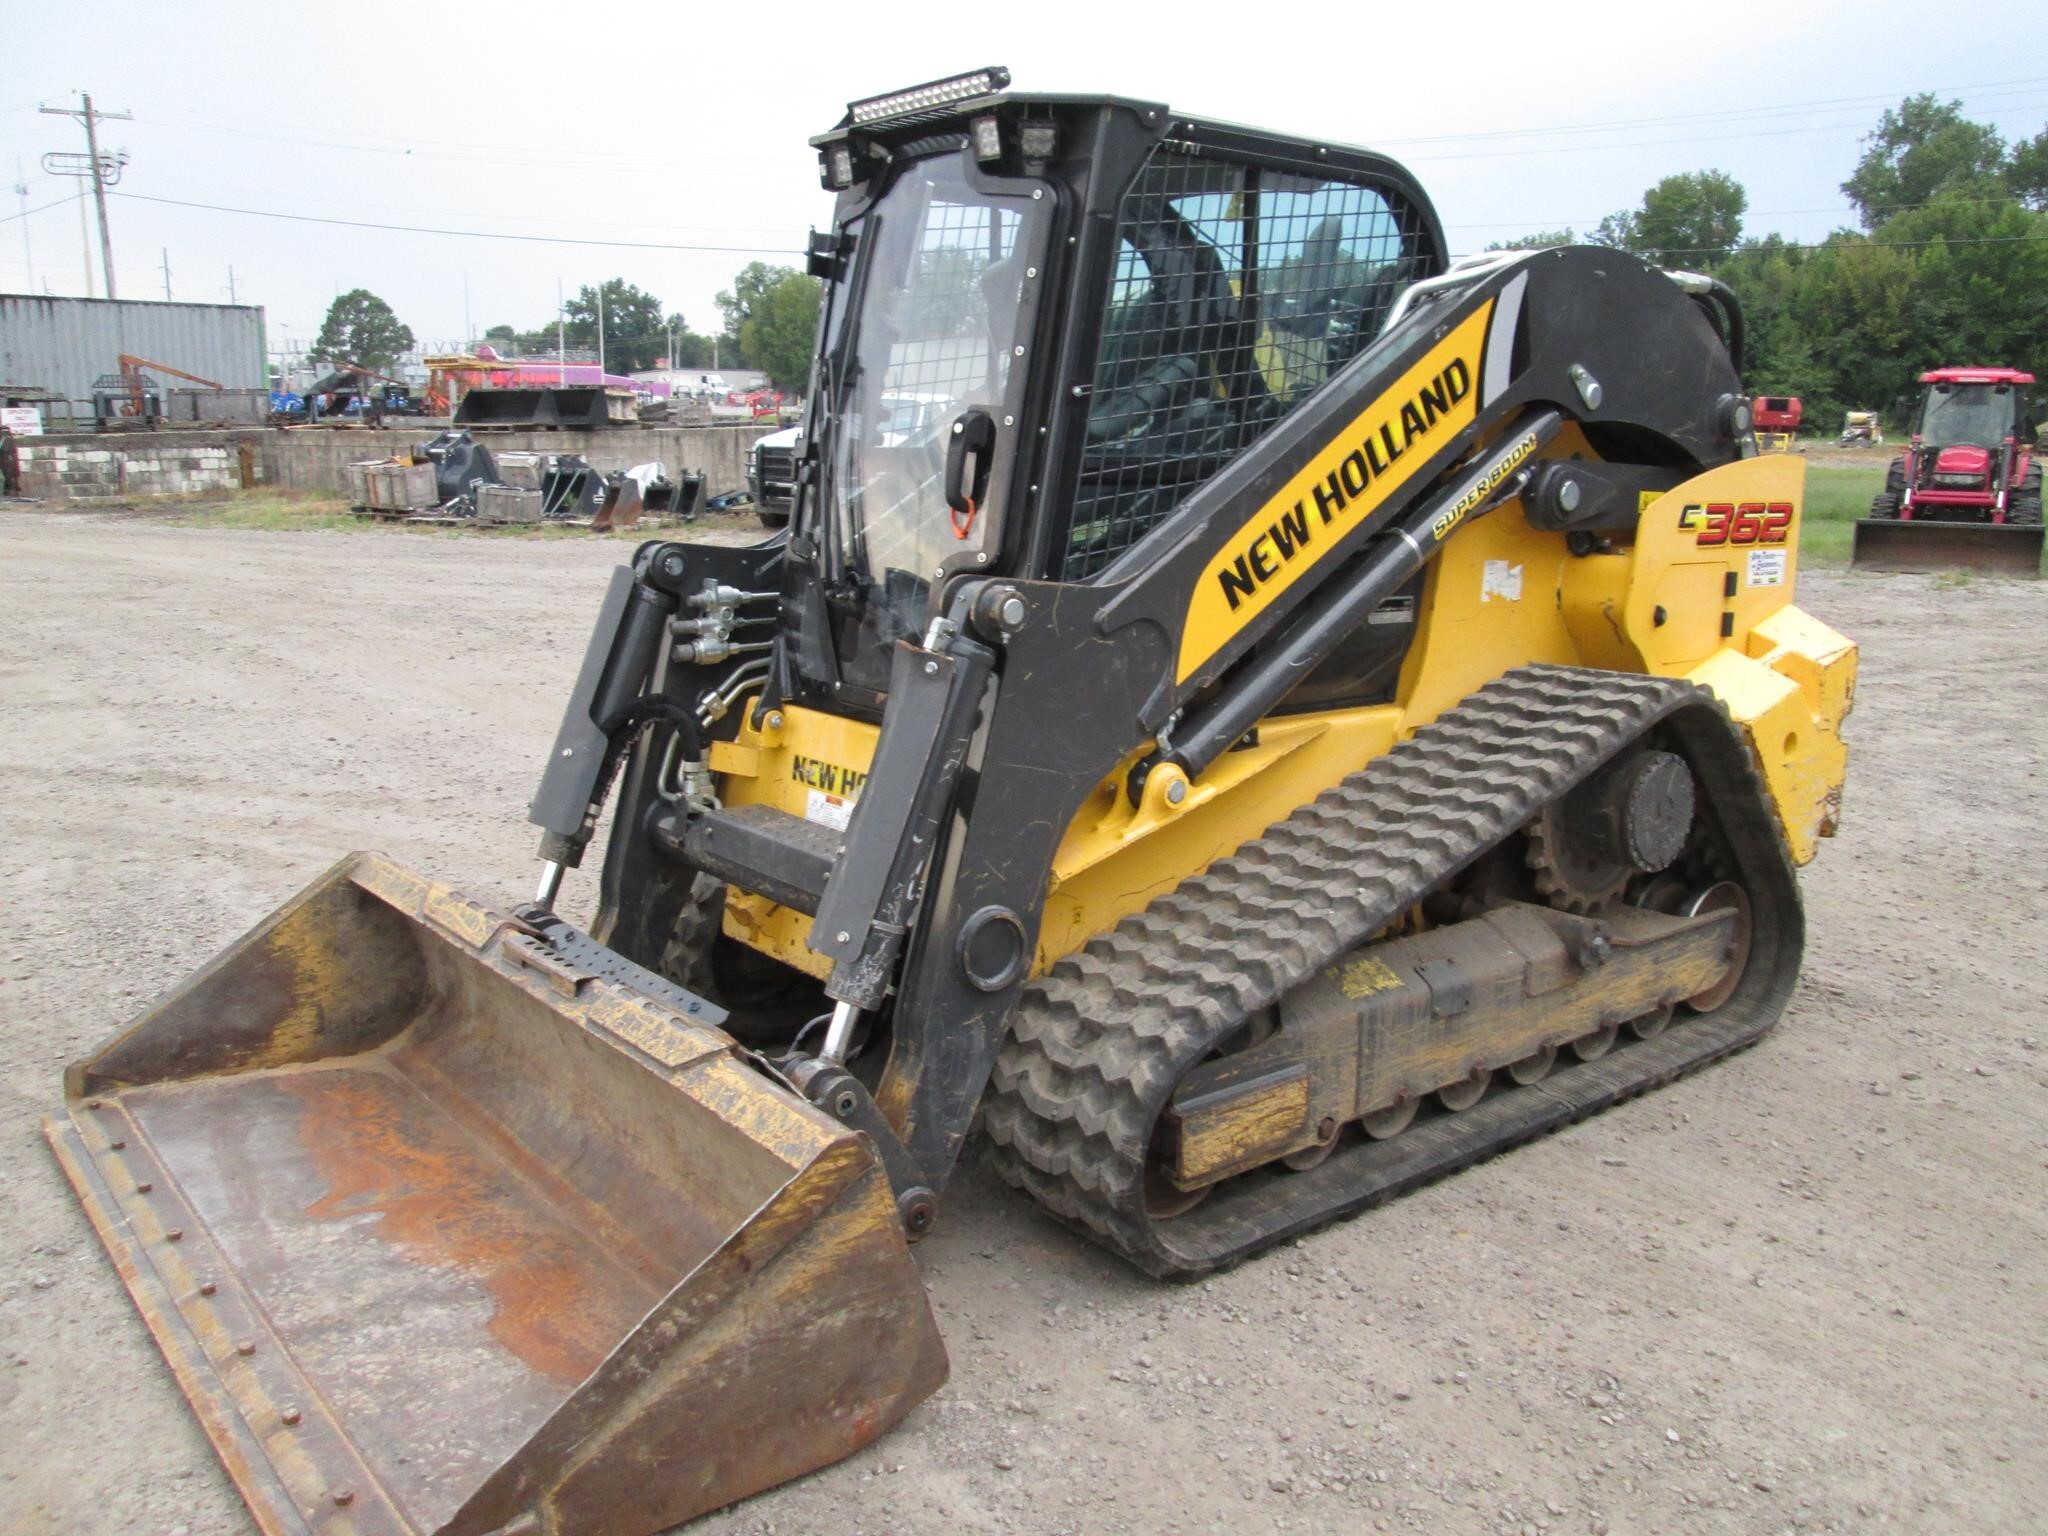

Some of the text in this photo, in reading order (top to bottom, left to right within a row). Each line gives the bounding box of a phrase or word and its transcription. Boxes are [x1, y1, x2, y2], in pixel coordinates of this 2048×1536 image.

[1217, 356, 1471, 611] NEW HOLLAND
[792, 754, 838, 791] NEW
